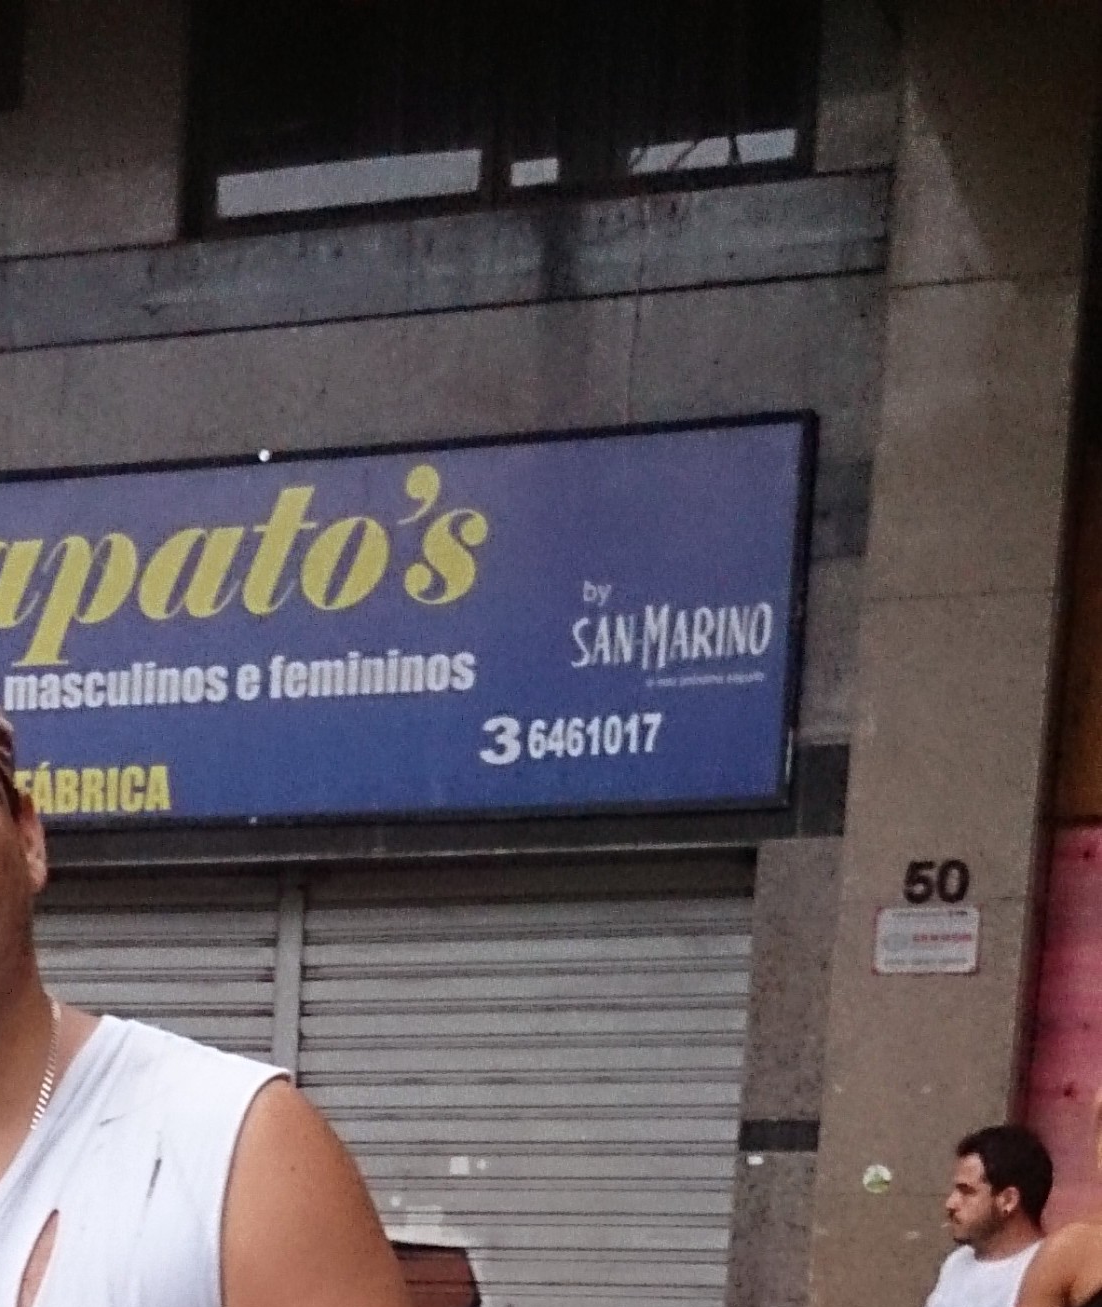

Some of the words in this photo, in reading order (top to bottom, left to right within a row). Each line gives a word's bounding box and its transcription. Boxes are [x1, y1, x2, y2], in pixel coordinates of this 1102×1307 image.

[582, 579, 612, 607] by
[641, 602, 773, 671] MARINO
[3, 660, 229, 712] masculinos
[235, 662, 261, 702] e
[269, 649, 477, 699] femininos
[903, 859, 970, 904] 50
